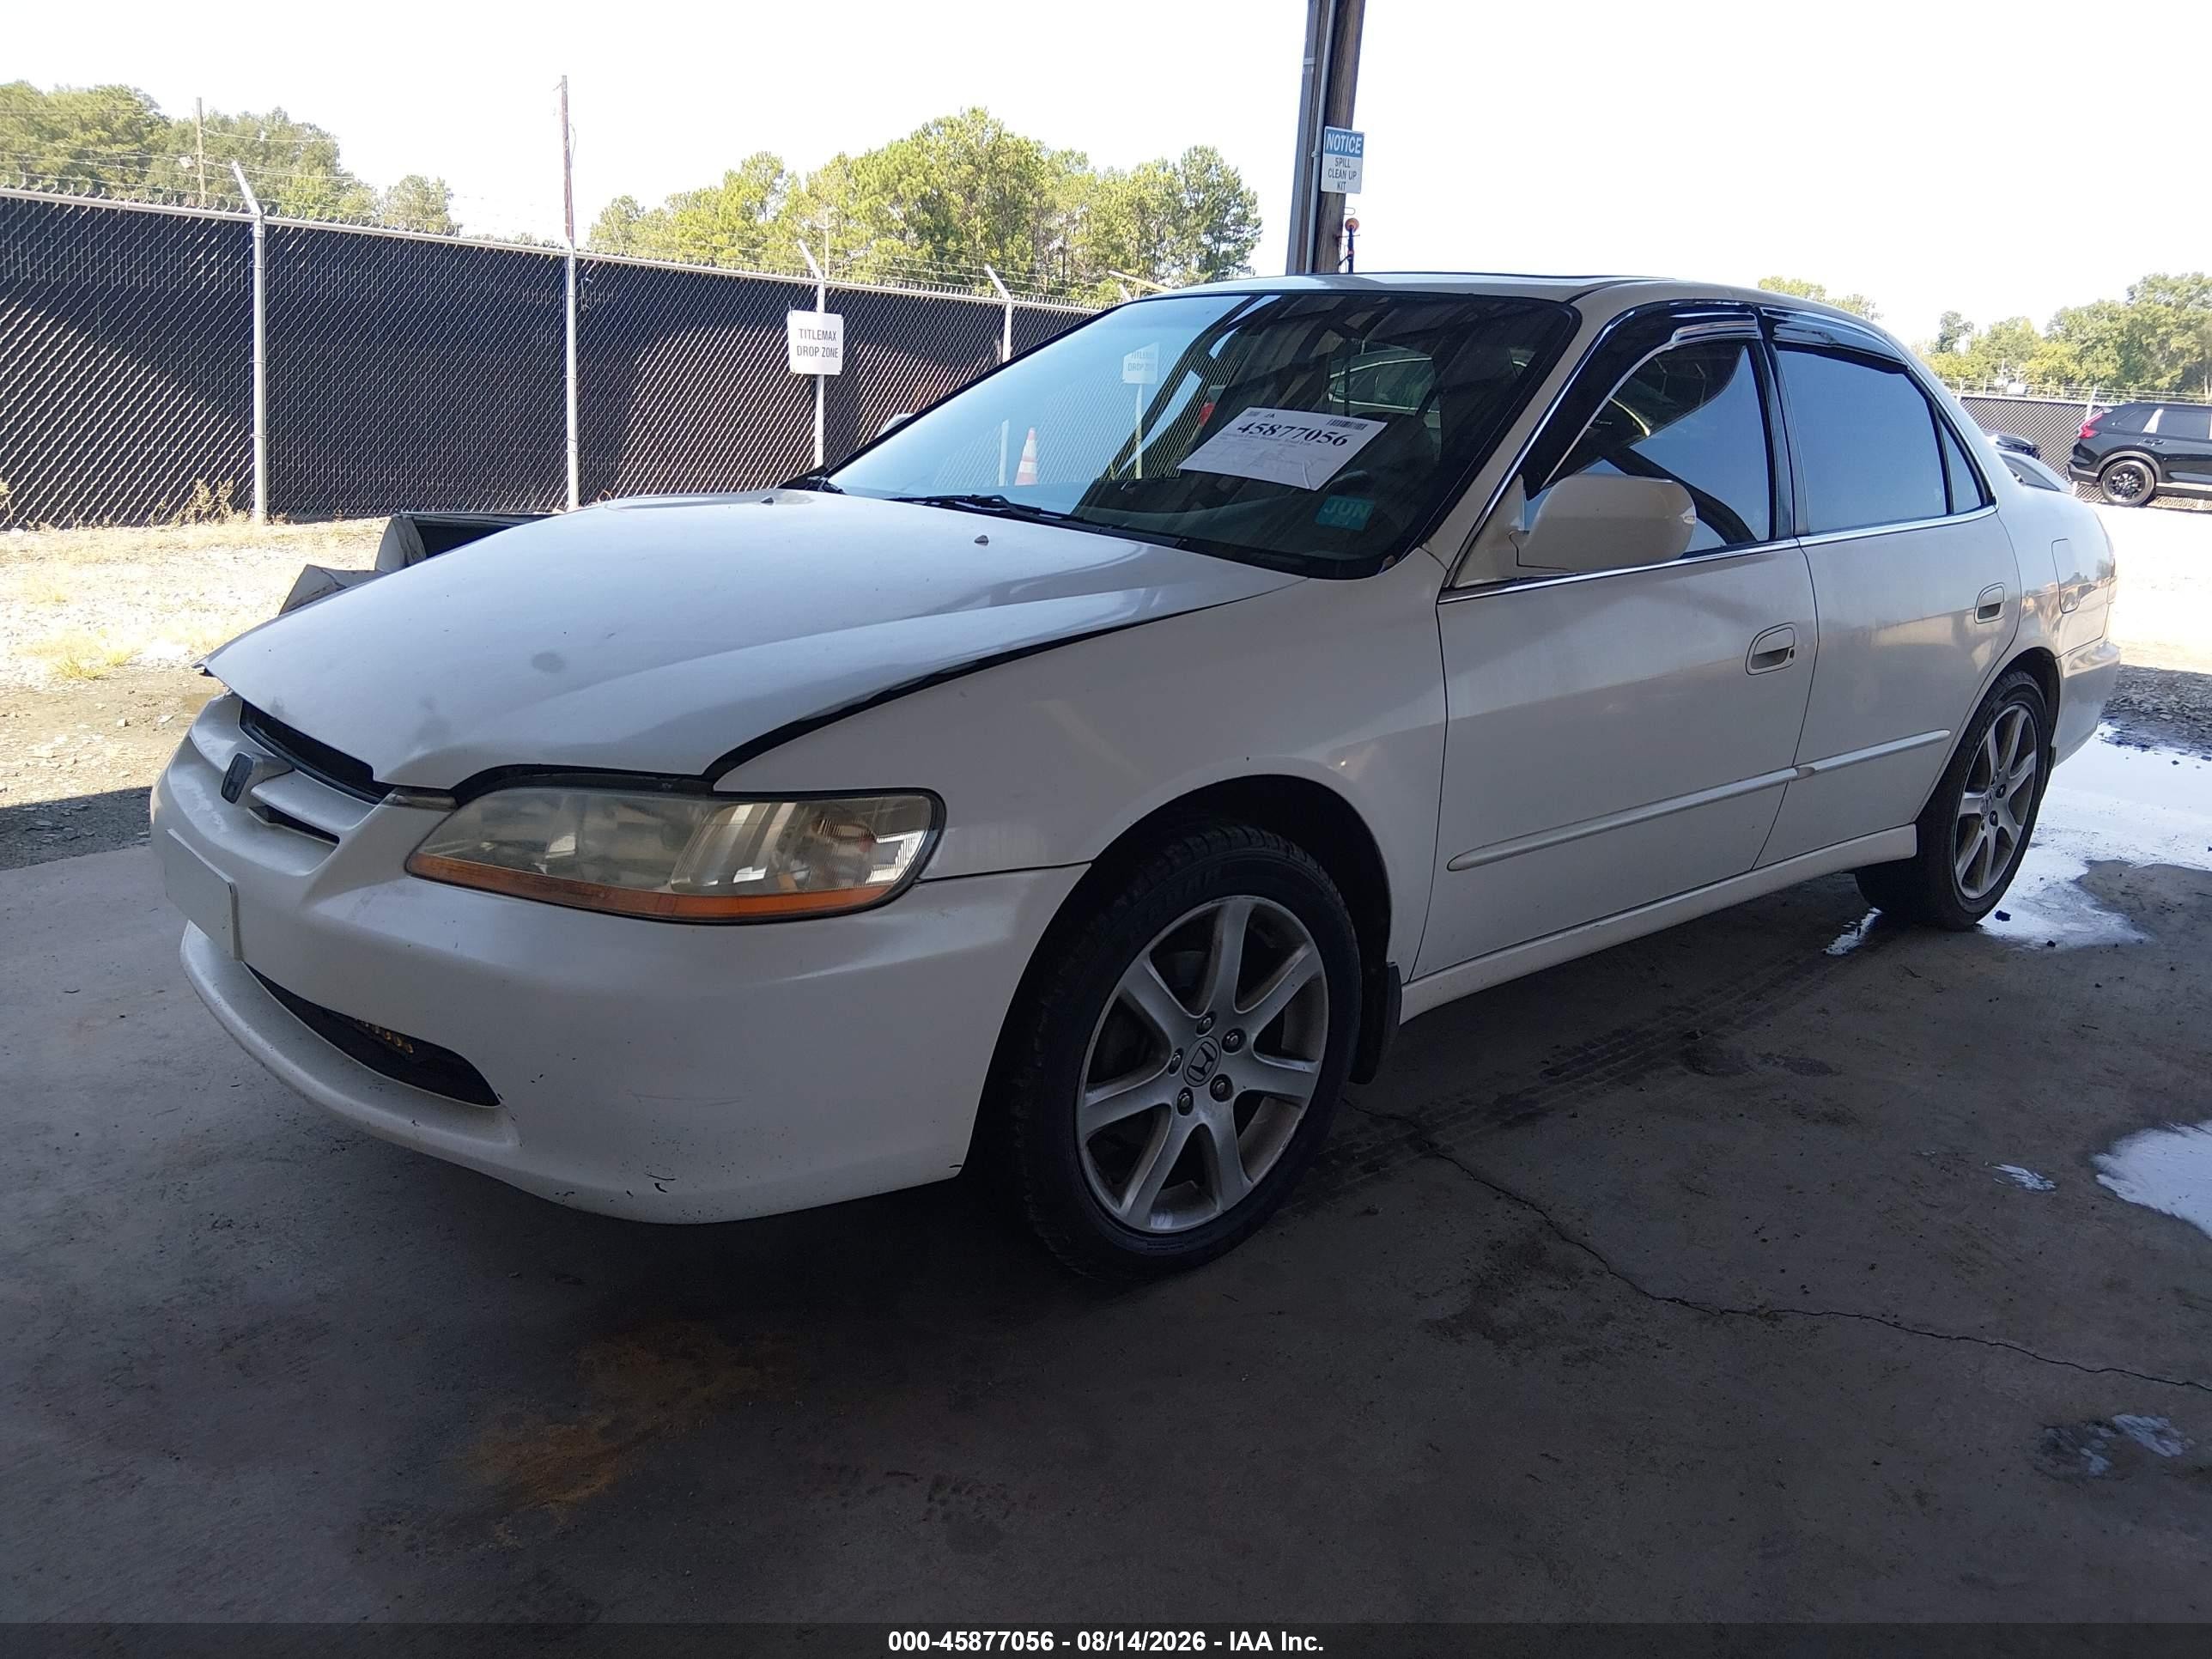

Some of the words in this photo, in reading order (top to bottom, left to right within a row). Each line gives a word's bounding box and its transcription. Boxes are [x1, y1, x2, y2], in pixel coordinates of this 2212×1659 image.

[1326, 135, 1362, 154] NOTICE
[1334, 157, 1351, 168] SPILL
[1328, 169, 1346, 179] CLEAN
[1348, 171, 1357, 180] UP
[1337, 181, 1346, 191] KIT
[798, 328, 836, 341] TITLEMAX
[797, 345, 820, 357] DROP
[821, 346, 839, 358] ZONE
[1237, 422, 1352, 446] 45877056
